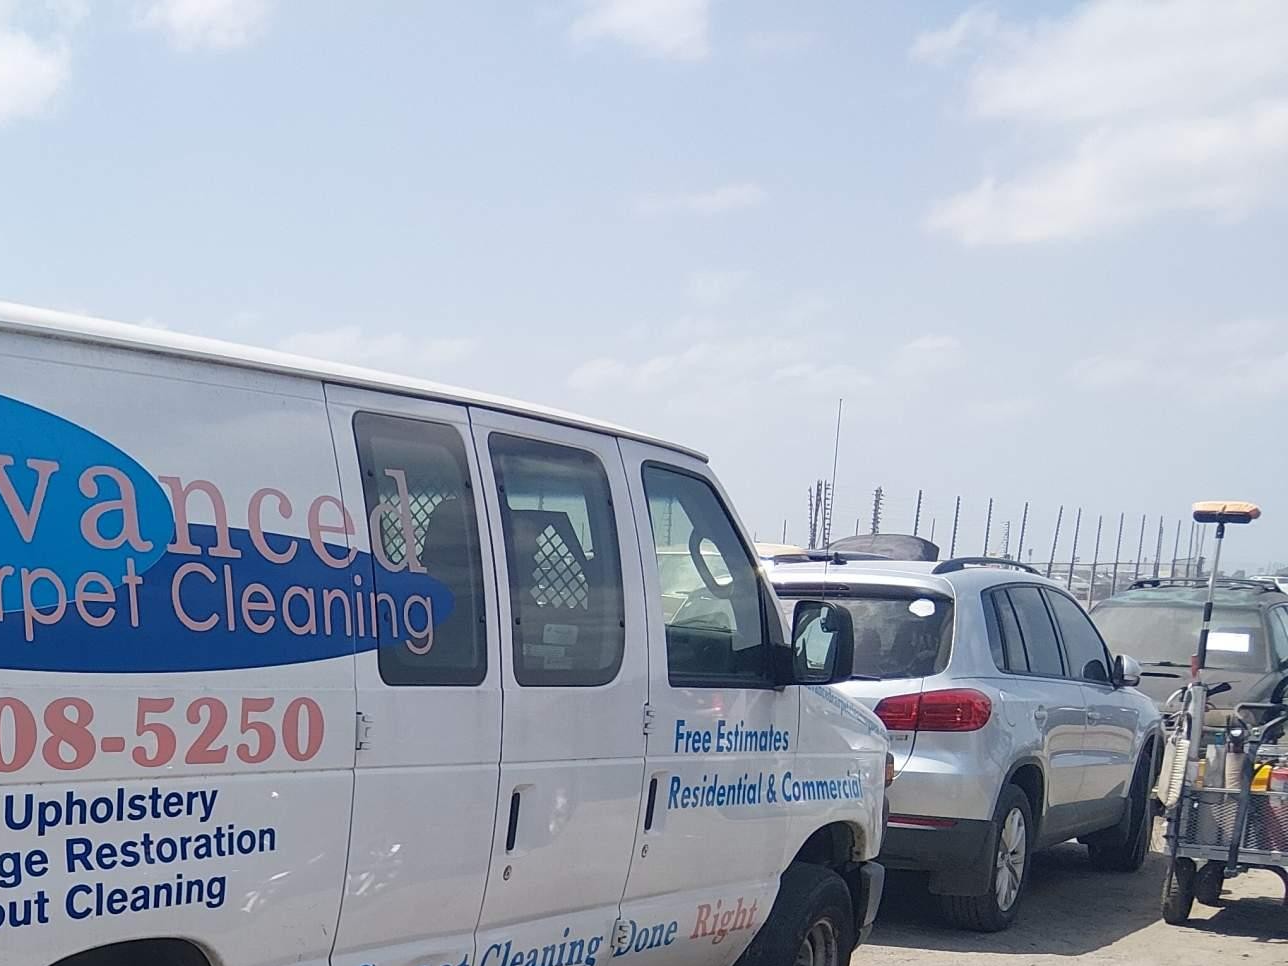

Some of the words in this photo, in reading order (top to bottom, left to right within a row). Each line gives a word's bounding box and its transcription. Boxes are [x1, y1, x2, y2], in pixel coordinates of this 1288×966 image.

[171, 562, 435, 654] Cleaning
[674, 719, 713, 753] Free
[716, 719, 790, 752] Estimates
[4, 787, 219, 833] Upholstery
[667, 772, 762, 810] Residential
[766, 771, 778, 803] &
[782, 771, 864, 802] Commercial
[65, 823, 277, 873] Restoration
[63, 870, 227, 919] Cleaning
[614, 917, 678, 957] Done
[689, 896, 758, 945] Right
